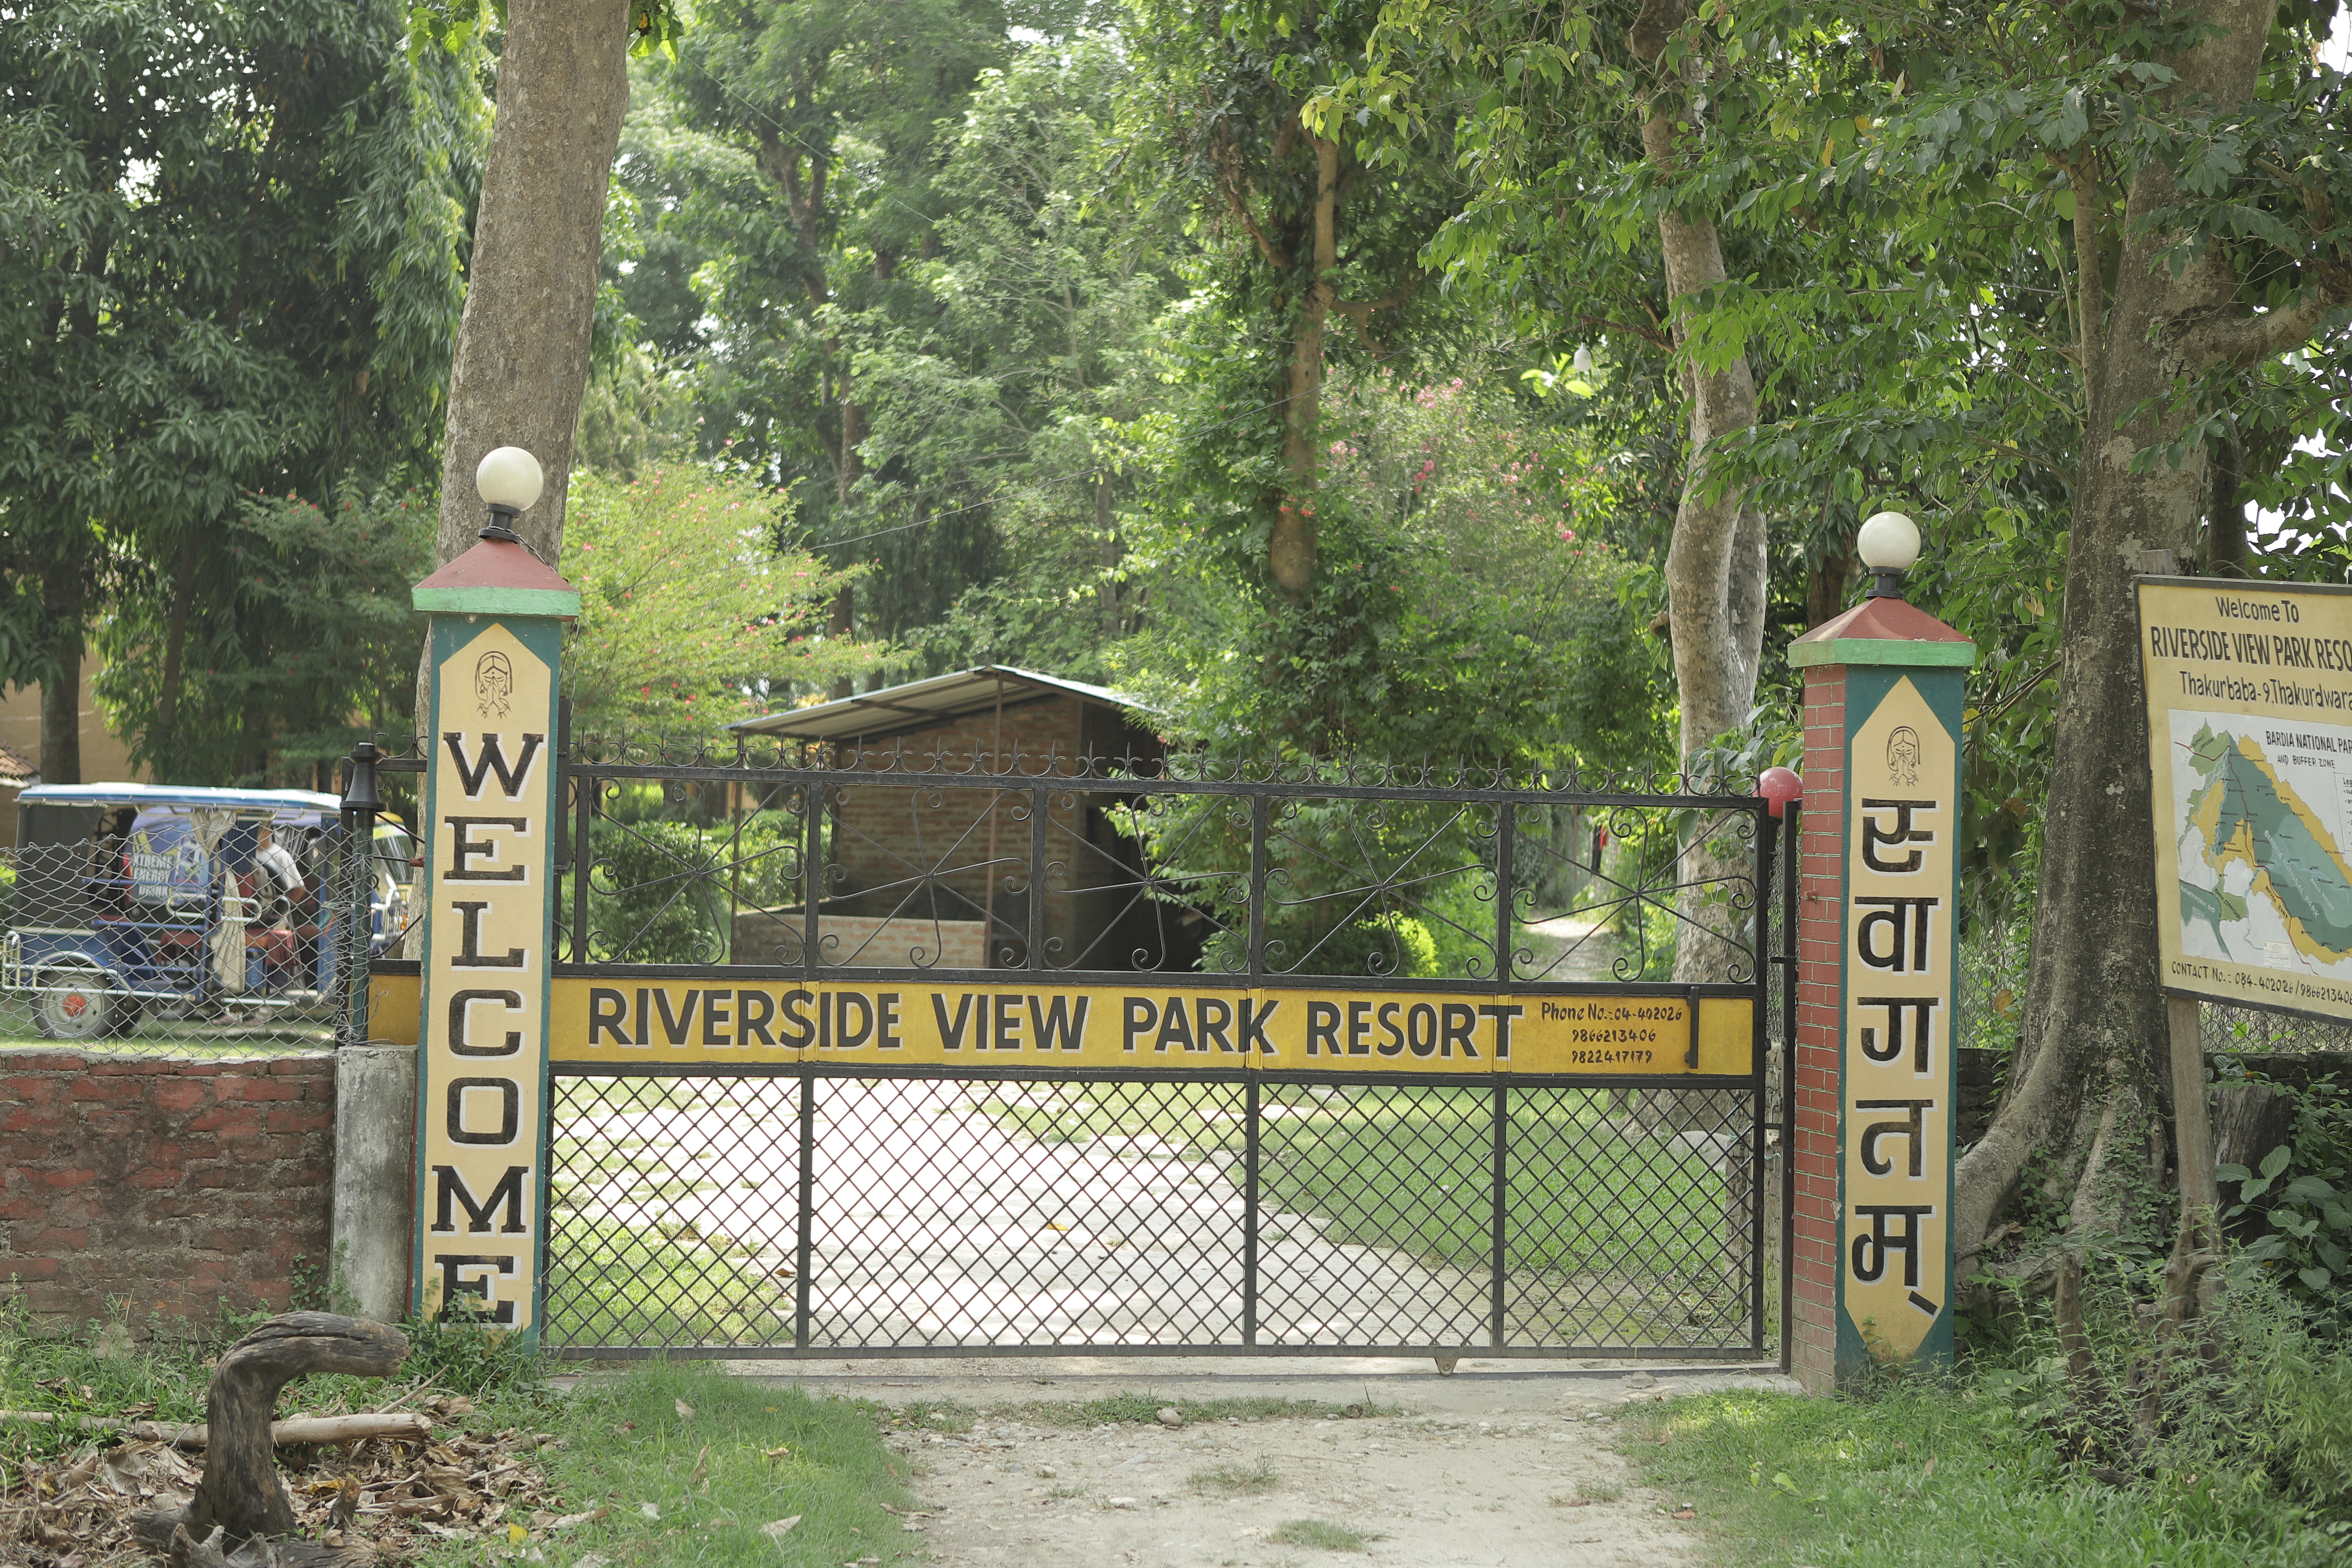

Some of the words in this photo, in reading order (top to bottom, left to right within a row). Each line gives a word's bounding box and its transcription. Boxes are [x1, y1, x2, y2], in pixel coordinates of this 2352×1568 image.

[2216, 596, 2280, 622] Welcome
[2281, 600, 2300, 623] To
[2151, 626, 2231, 661] RIVERSIDE
[2232, 632, 2271, 665] VIEW
[2273, 635, 2315, 668] PARK
[2266, 730, 2295, 748] BARDIA
[2295, 733, 2337, 753] NATIONAL
[2278, 754, 2289, 765] AND
[2292, 755, 2317, 767] BUFFER
[2318, 758, 2335, 769] ZONE
[2172, 961, 2209, 980] CONTACT
[589, 987, 901, 1049] RIVERSIDE
[931, 993, 1090, 1051] VIEW
[1123, 996, 1280, 1054] PARK
[1307, 1001, 1523, 1057] RESORT
[1542, 1001, 1585, 1021] Phone
[431, 732, 544, 1323] WELCOME
[1573, 1029, 1656, 1043] 9866213406
[1572, 1049, 1652, 1064] 9822417179
[1852, 798, 1940, 1316] स्वागतम्
